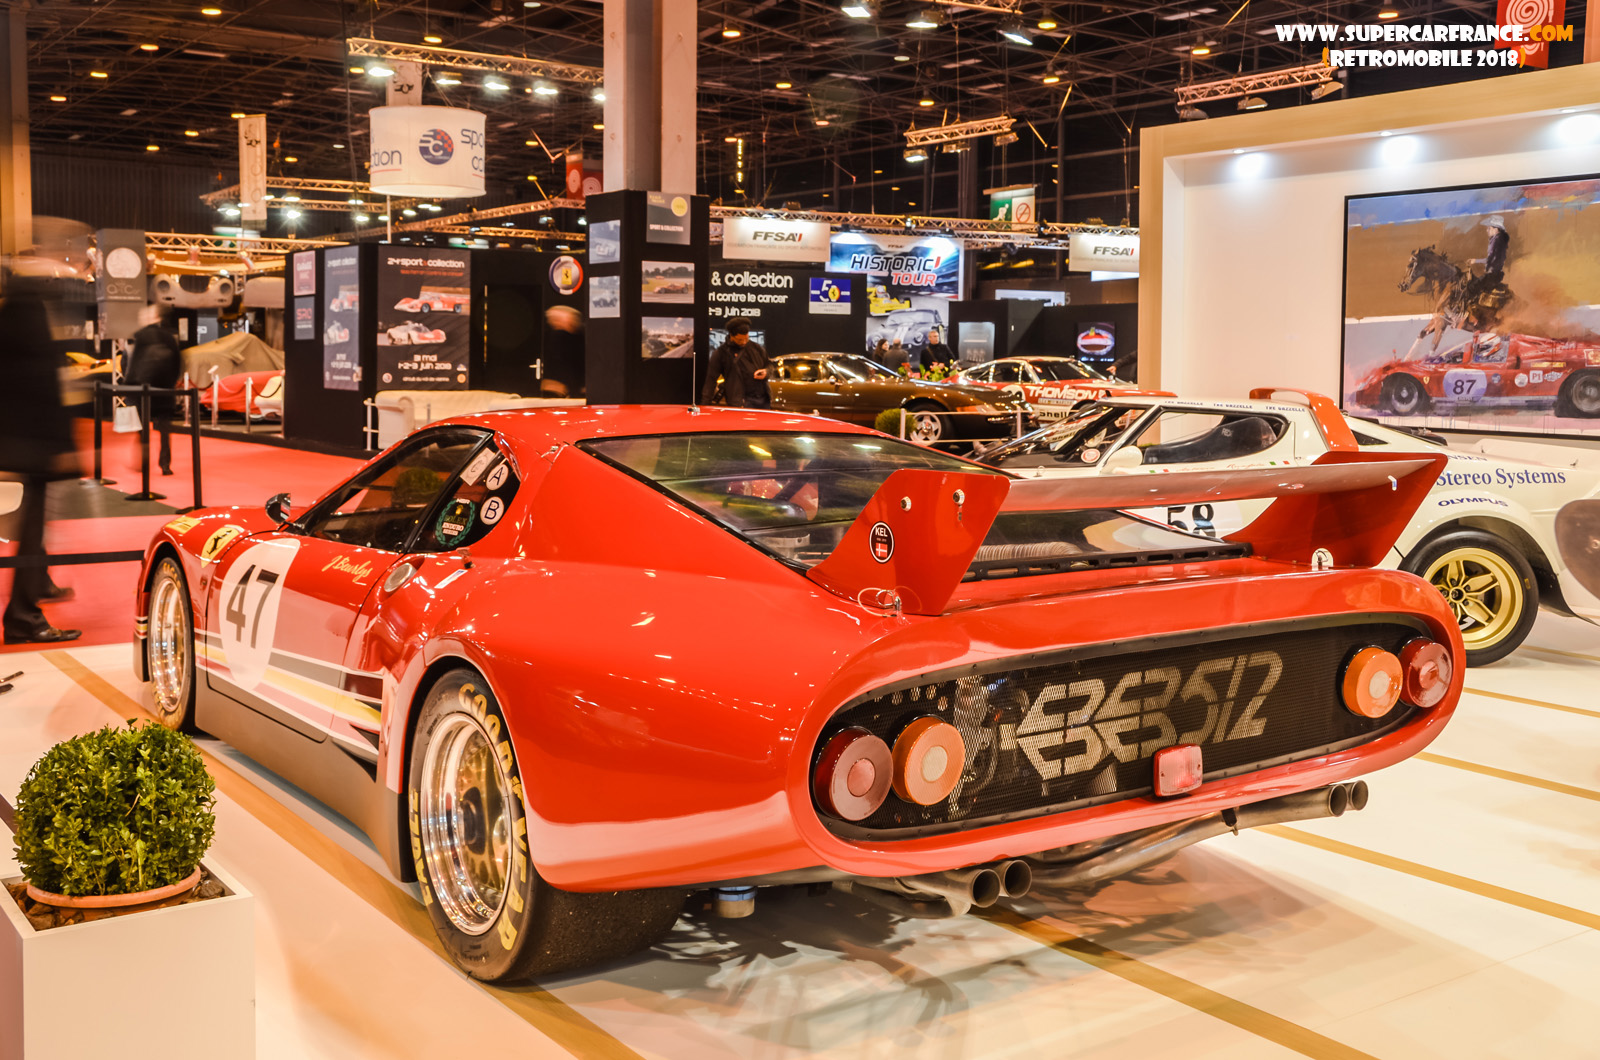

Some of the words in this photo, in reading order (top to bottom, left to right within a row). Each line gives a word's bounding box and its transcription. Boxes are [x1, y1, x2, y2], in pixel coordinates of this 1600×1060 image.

[752, 231, 796, 242] FFSA
[1093, 246, 1130, 256] FFSA
[850, 253, 935, 272] HISTORIC
[724, 271, 793, 288] collection
[891, 272, 937, 286] TOUR
[716, 293, 745, 303] contre
[1029, 387, 1098, 400] THOMSON
[1453, 379, 1476, 395] 87
[489, 467, 504, 485] A
[1436, 470, 1492, 486] Stereo
[1495, 468, 1566, 488] Systems
[484, 500, 499, 519] B
[1438, 497, 1508, 507] OLYMPUS
[875, 527, 888, 537] KEL
[226, 564, 280, 650] 47
